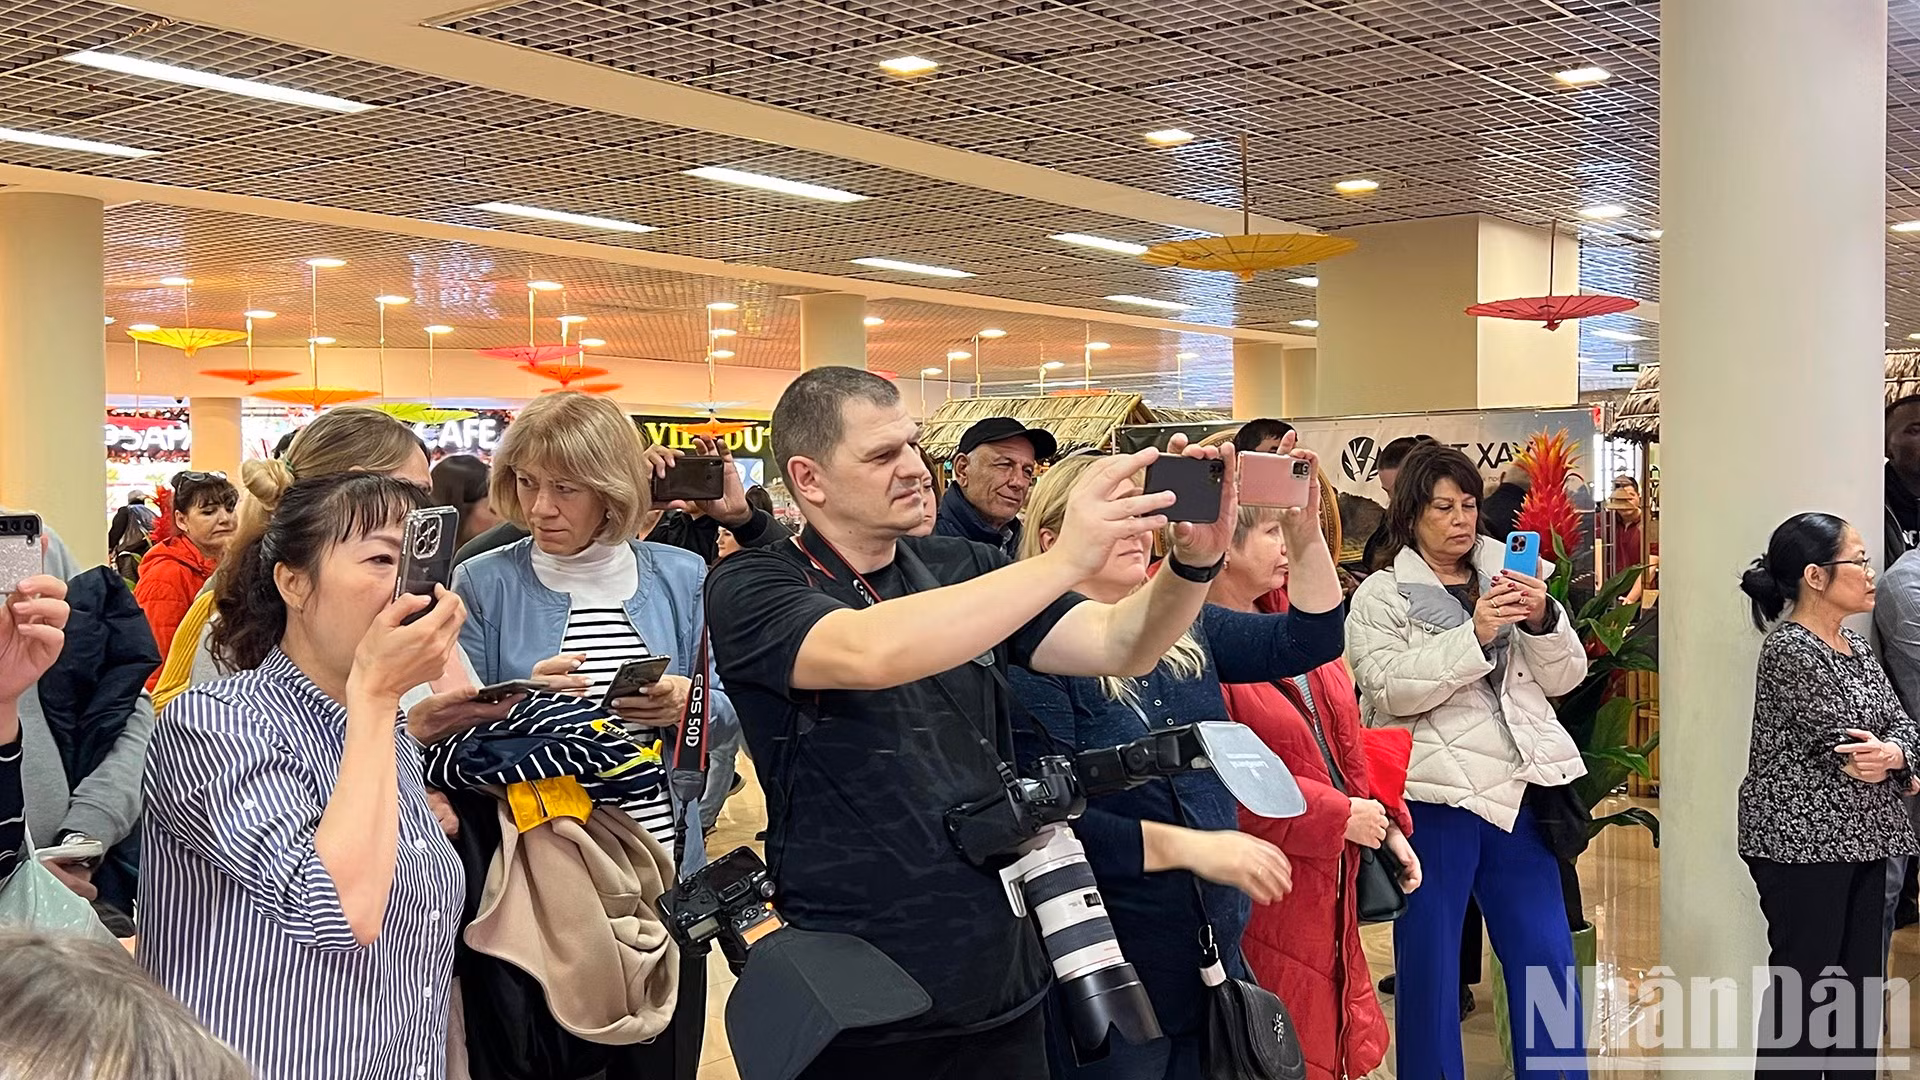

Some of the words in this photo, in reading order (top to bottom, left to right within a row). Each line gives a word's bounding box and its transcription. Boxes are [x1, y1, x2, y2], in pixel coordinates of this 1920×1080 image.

[414, 419, 497, 450] CAFE
[691, 673, 703, 714] EOS
[685, 718, 701, 747] 50D
